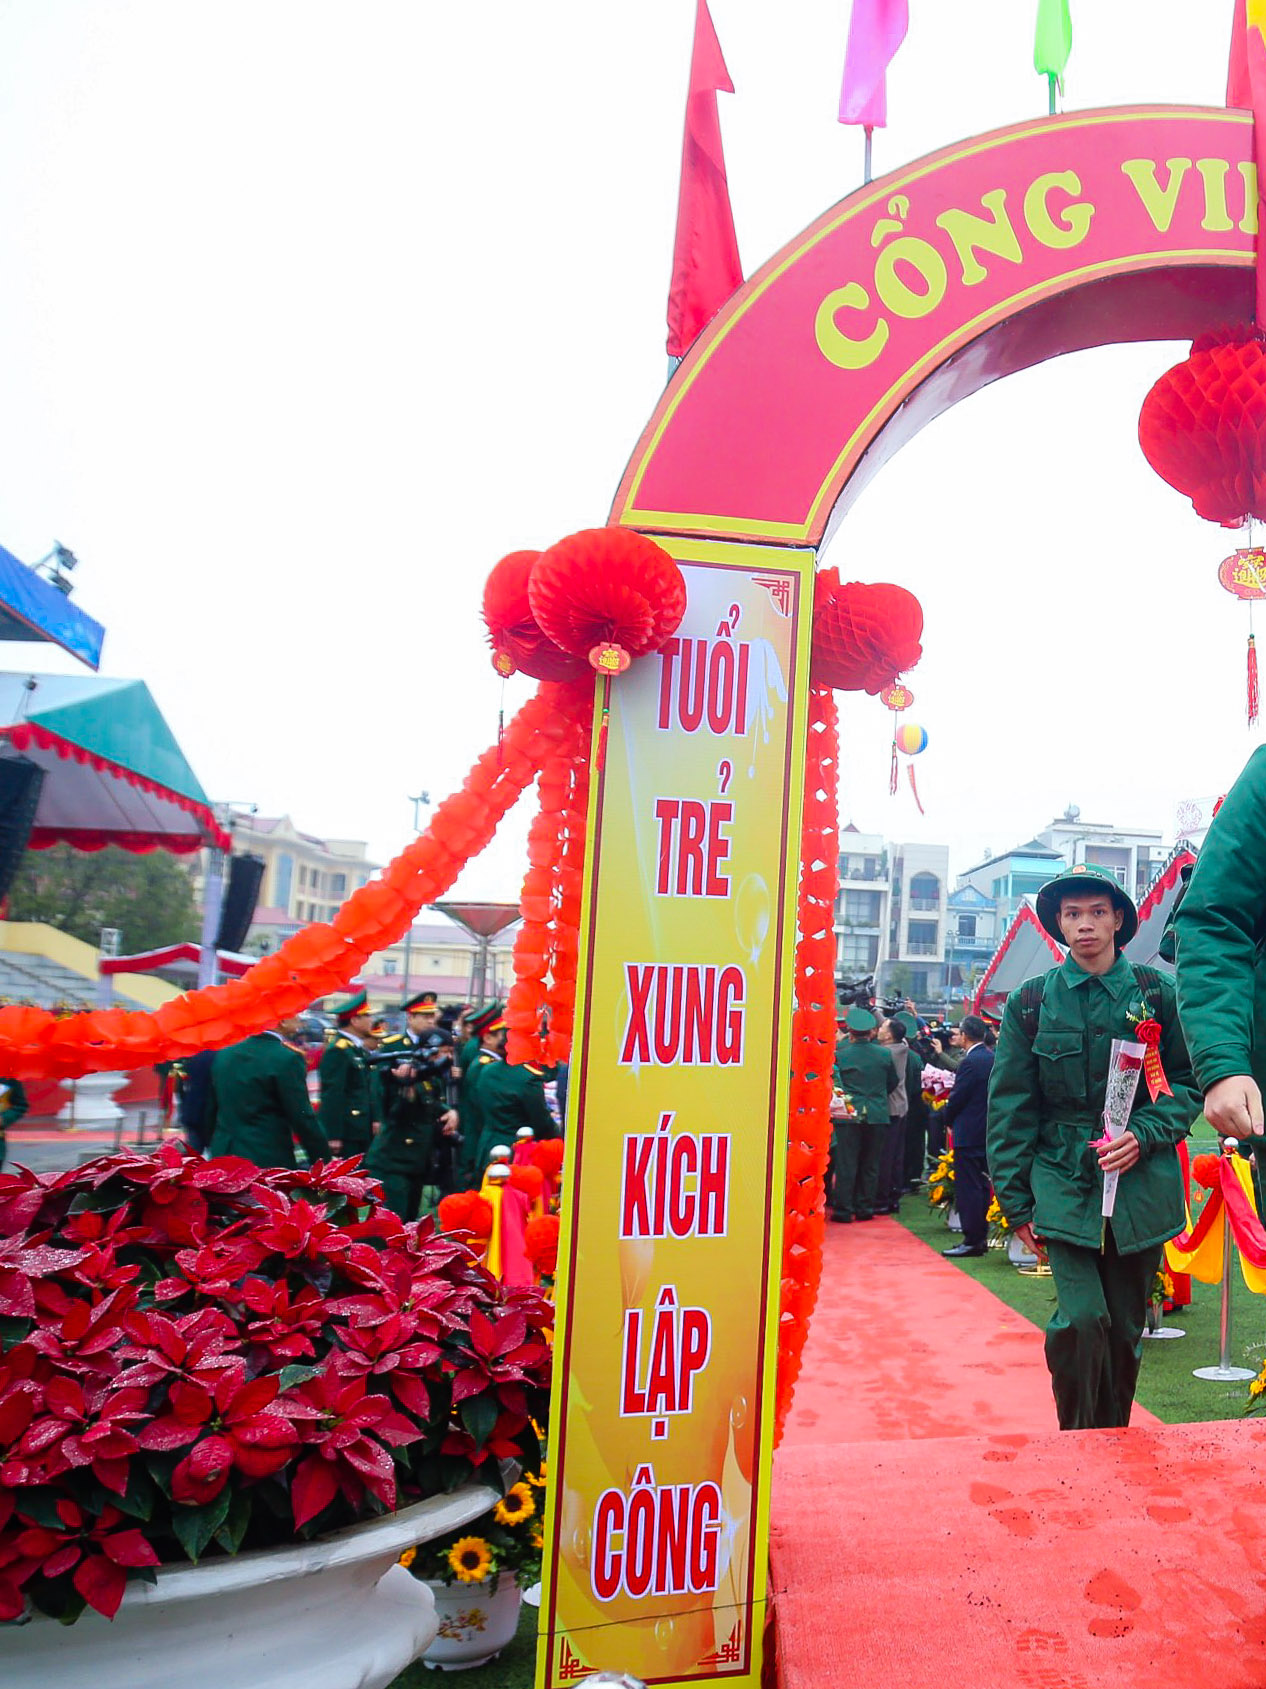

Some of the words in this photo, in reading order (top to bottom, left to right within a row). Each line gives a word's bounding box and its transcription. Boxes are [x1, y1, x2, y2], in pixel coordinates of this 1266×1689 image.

[814, 169, 1095, 370] CỔNG
[1121, 157, 1259, 235] VI
[656, 603, 750, 736] TUỔI
[655, 760, 734, 899] TRẺ
[618, 962, 746, 1067] XUNG
[619, 1110, 732, 1240] KÍCH
[619, 1284, 712, 1441] LẬP
[590, 1462, 723, 1602] CÔNG
